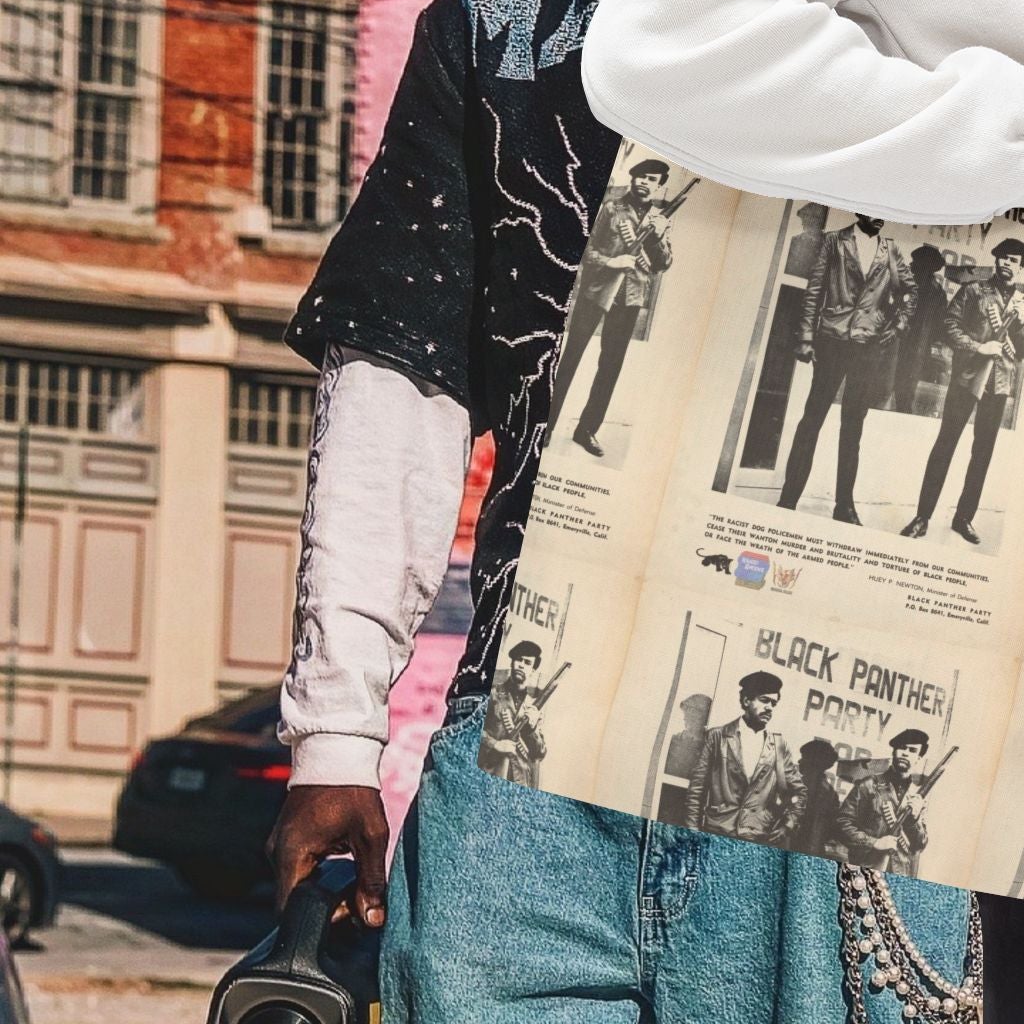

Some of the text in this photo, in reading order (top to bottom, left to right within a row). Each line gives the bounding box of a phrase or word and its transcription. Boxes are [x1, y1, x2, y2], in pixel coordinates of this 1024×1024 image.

[550, 511, 583, 524] PANTHER
[706, 523, 725, 532] CEASE
[728, 528, 746, 536] THEIR
[750, 533, 778, 544] WANTON
[781, 541, 807, 550] MURDER
[809, 546, 824, 554] AND
[826, 550, 862, 563] BRUTALITY
[882, 562, 910, 573] TORTURE
[923, 571, 943, 581] BLACK
[716, 534, 732, 543] FACE
[734, 538, 747, 546] THE
[750, 542, 773, 552] WRATH
[802, 554, 824, 563] ARMED
[727, 518, 749, 528] RACIST
[752, 524, 765, 532] DOG
[768, 528, 803, 540] POLICEMEN
[806, 537, 824, 545] MUST
[826, 541, 863, 553] WITHDRAW
[865, 550, 910, 564] IMMEDIATELY
[912, 560, 929, 569] FROM
[932, 564, 944, 572] OUR
[907, 594, 992, 617] BLACK PANTHER PARTY
[755, 627, 946, 718] BLACK PANTHER
[802, 688, 892, 741] PARTY
